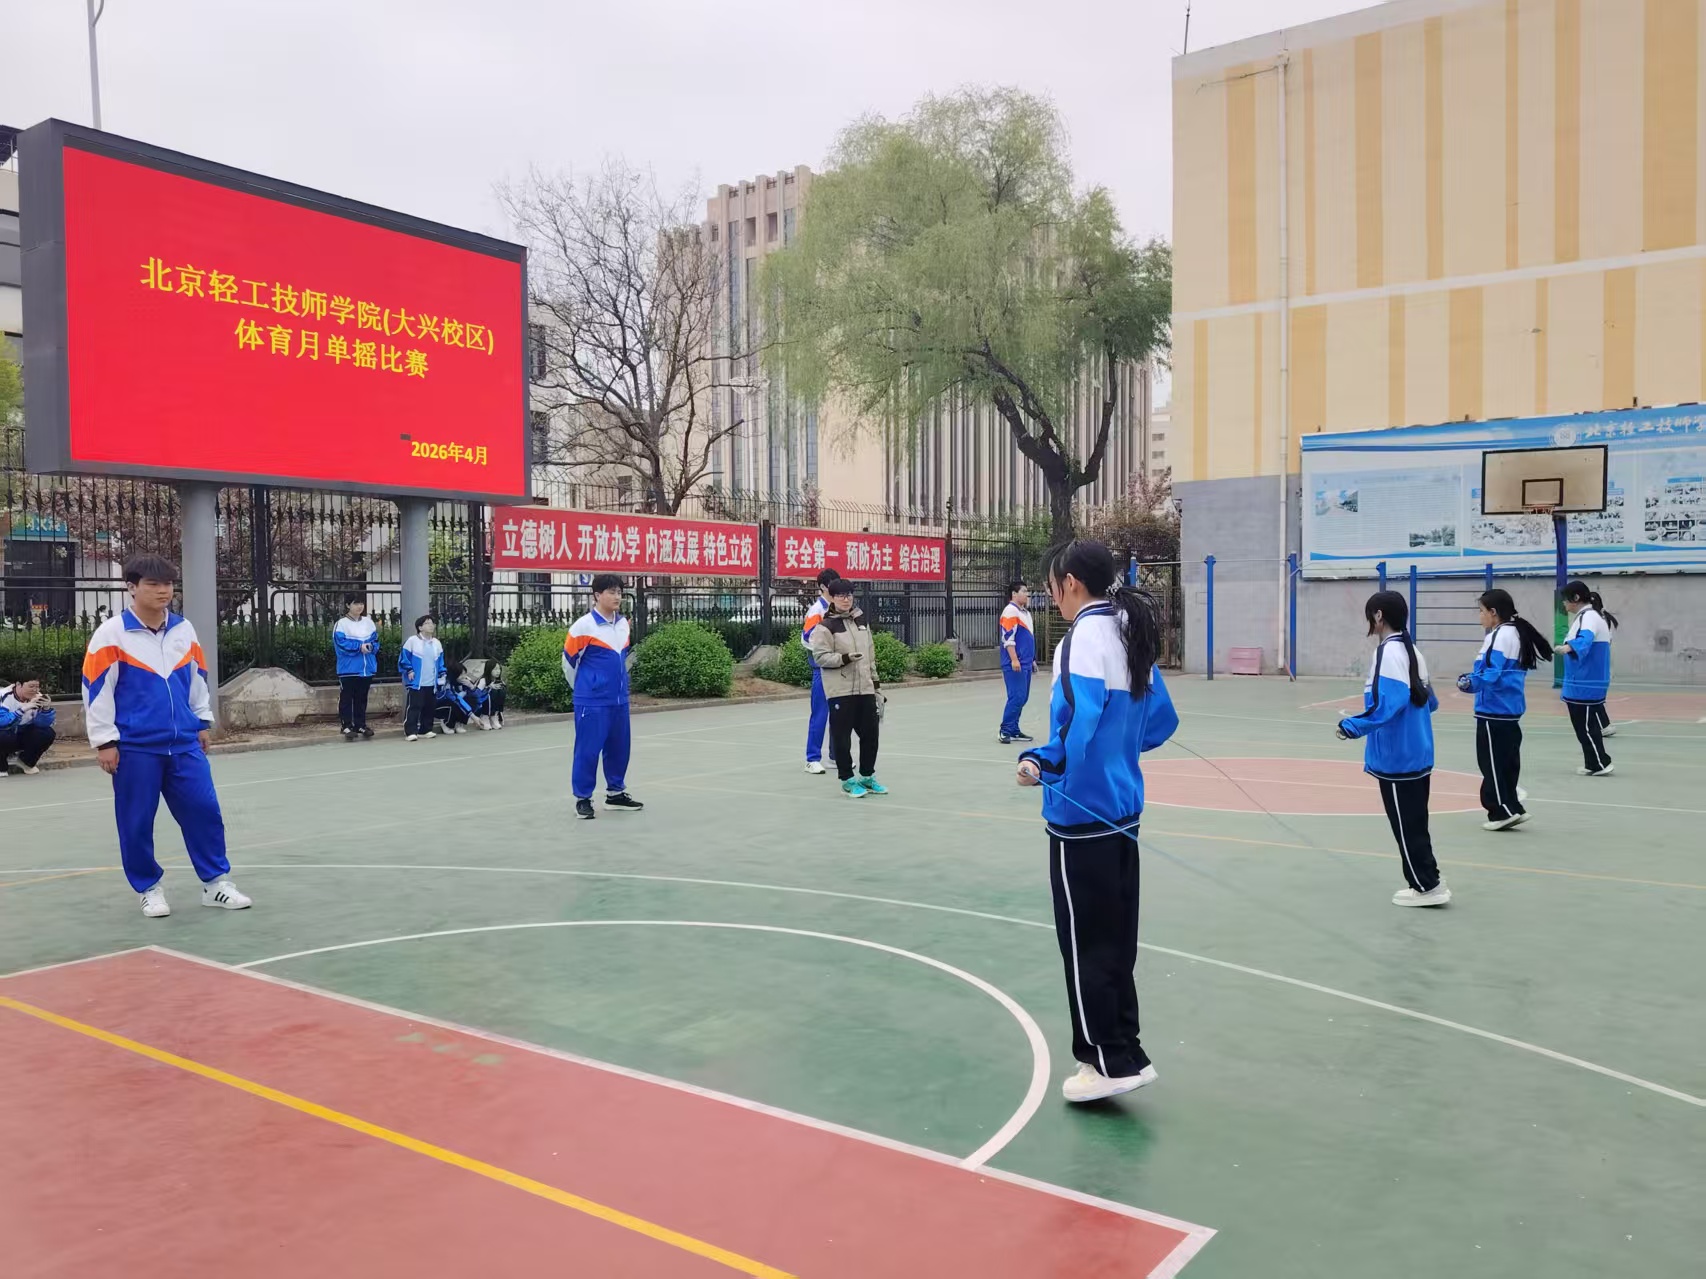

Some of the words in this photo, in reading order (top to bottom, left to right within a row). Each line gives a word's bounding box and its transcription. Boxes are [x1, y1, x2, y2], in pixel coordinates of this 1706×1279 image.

[140, 257, 494, 355] 北京轻工技师学院(大兴校区)
[234, 318, 428, 378] 体育月单摇比赛
[411, 441, 487, 465] 2026年4月
[502, 518, 572, 560] 立德树人
[578, 524, 640, 563] 开放办学
[646, 527, 699, 566] 内涵发展
[703, 531, 752, 567] 特色立校
[785, 536, 839, 569] 安全第一
[846, 541, 893, 571] 预防为主
[899, 544, 941, 573] 综合治理
